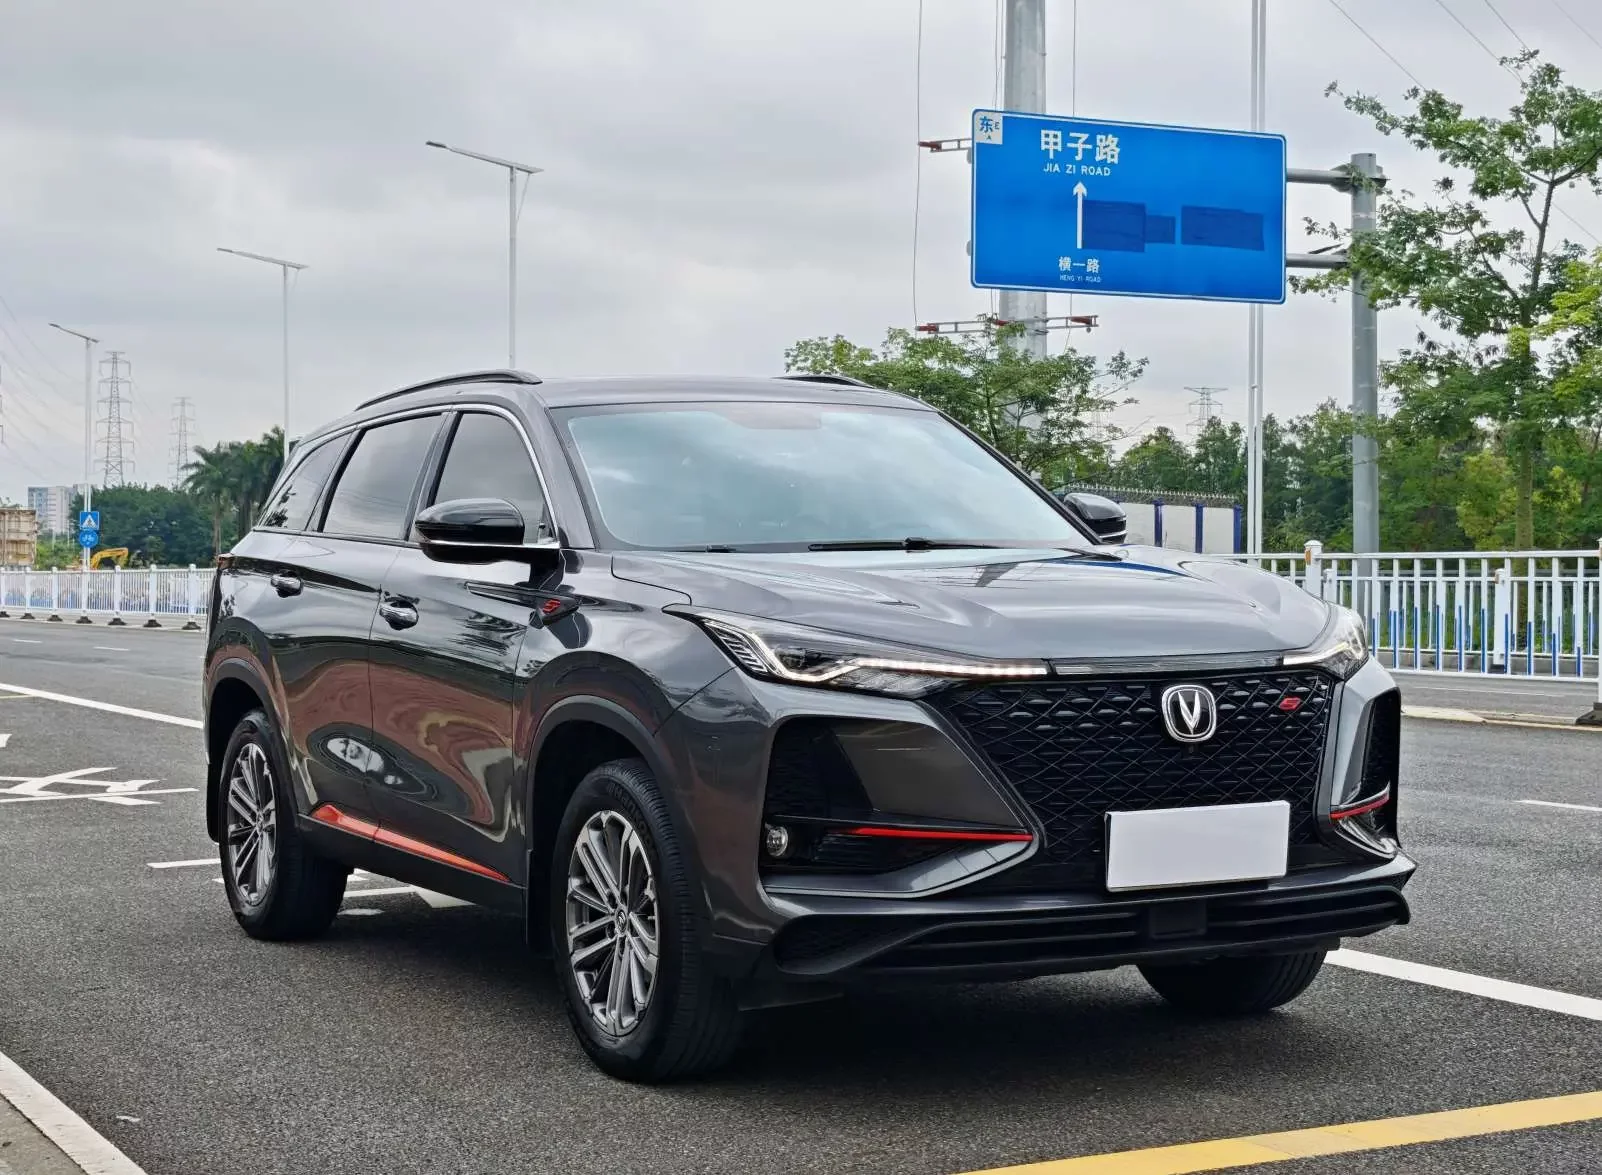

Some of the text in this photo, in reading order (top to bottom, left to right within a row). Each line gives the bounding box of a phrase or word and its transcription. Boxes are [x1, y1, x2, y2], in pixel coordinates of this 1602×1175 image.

[979, 115, 993, 133] 东
[1040, 129, 1120, 165] 甲子路
[1043, 163, 1111, 176] JIA ZI ROAD
[1059, 256, 1100, 273] 横一路
